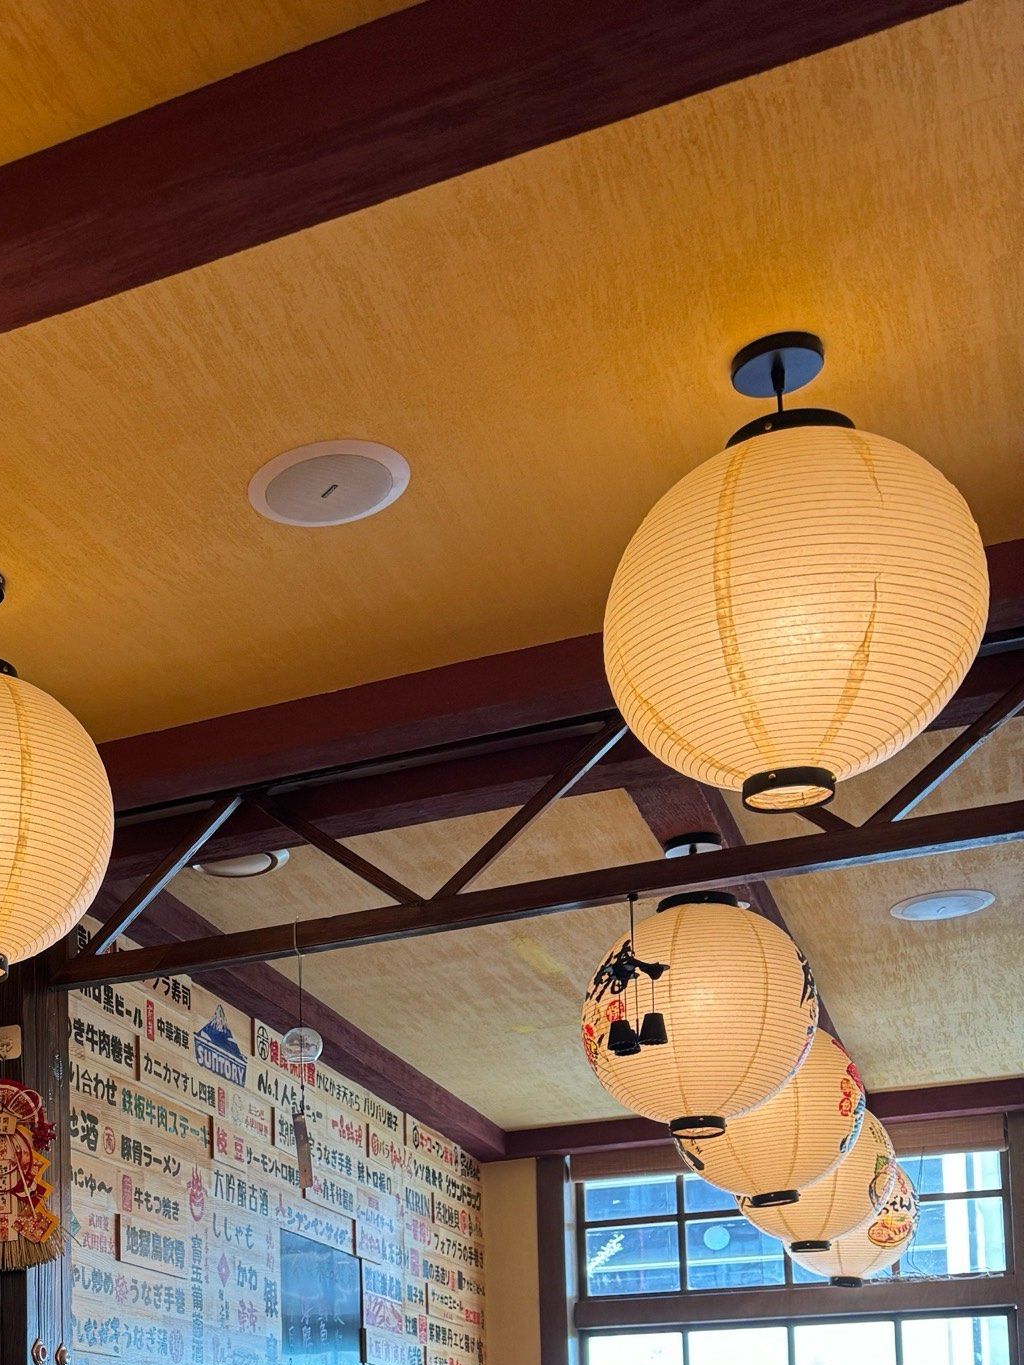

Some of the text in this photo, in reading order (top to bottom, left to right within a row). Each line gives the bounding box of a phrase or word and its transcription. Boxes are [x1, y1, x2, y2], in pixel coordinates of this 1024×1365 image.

[67, 1017, 135, 1069] き牛肉巻き
[197, 1045, 244, 1086] SUNTORY
[121, 1134, 181, 1177] 豚骨ラーメン
[406, 1186, 430, 1218] KIRIN
